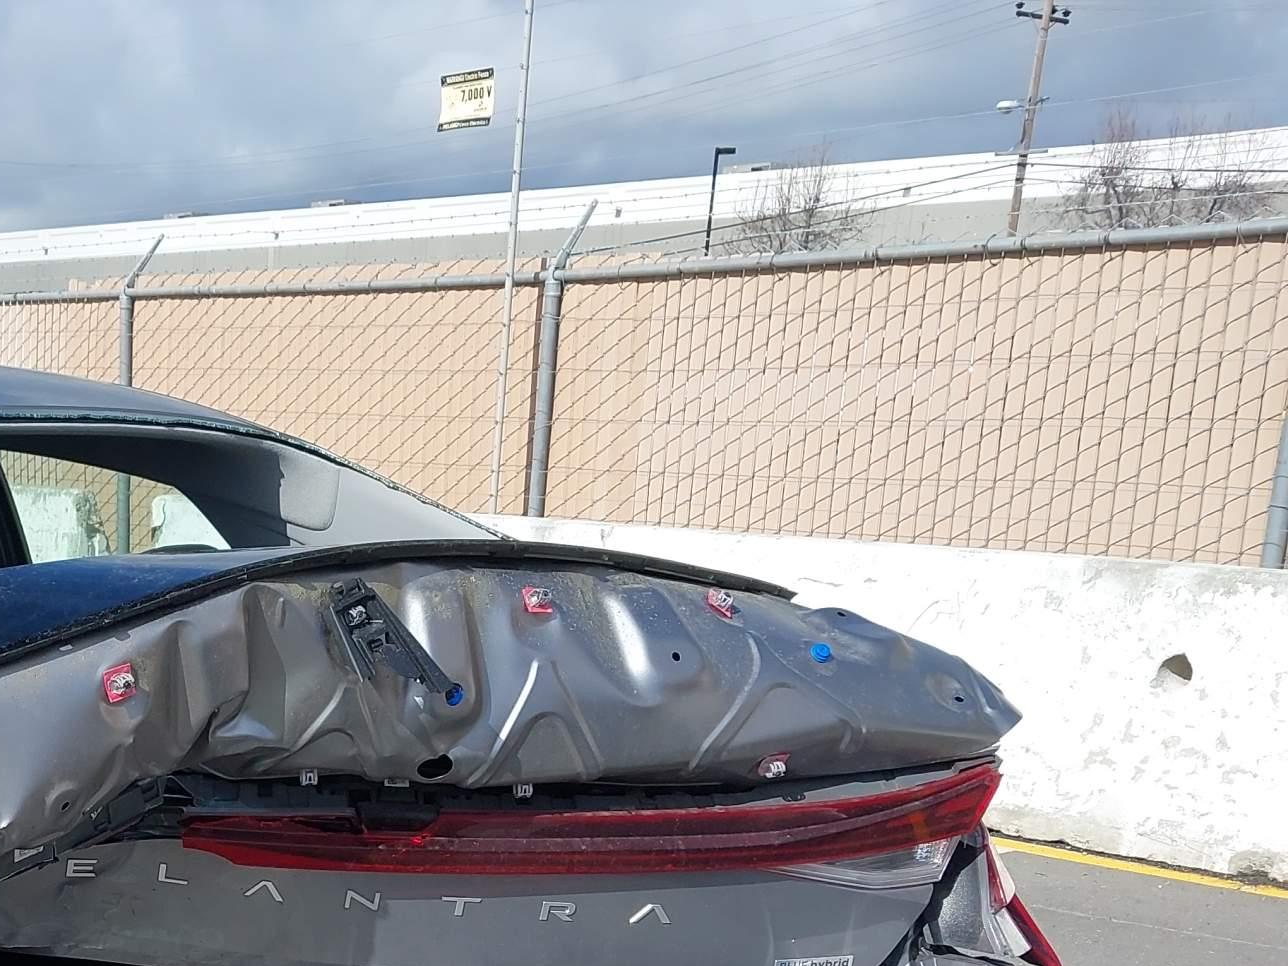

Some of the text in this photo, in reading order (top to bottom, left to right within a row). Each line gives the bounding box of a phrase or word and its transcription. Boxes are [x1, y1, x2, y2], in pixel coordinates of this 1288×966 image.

[461, 85, 493, 104] 7,000 V
[65, 859, 673, 925] ELANTRA
